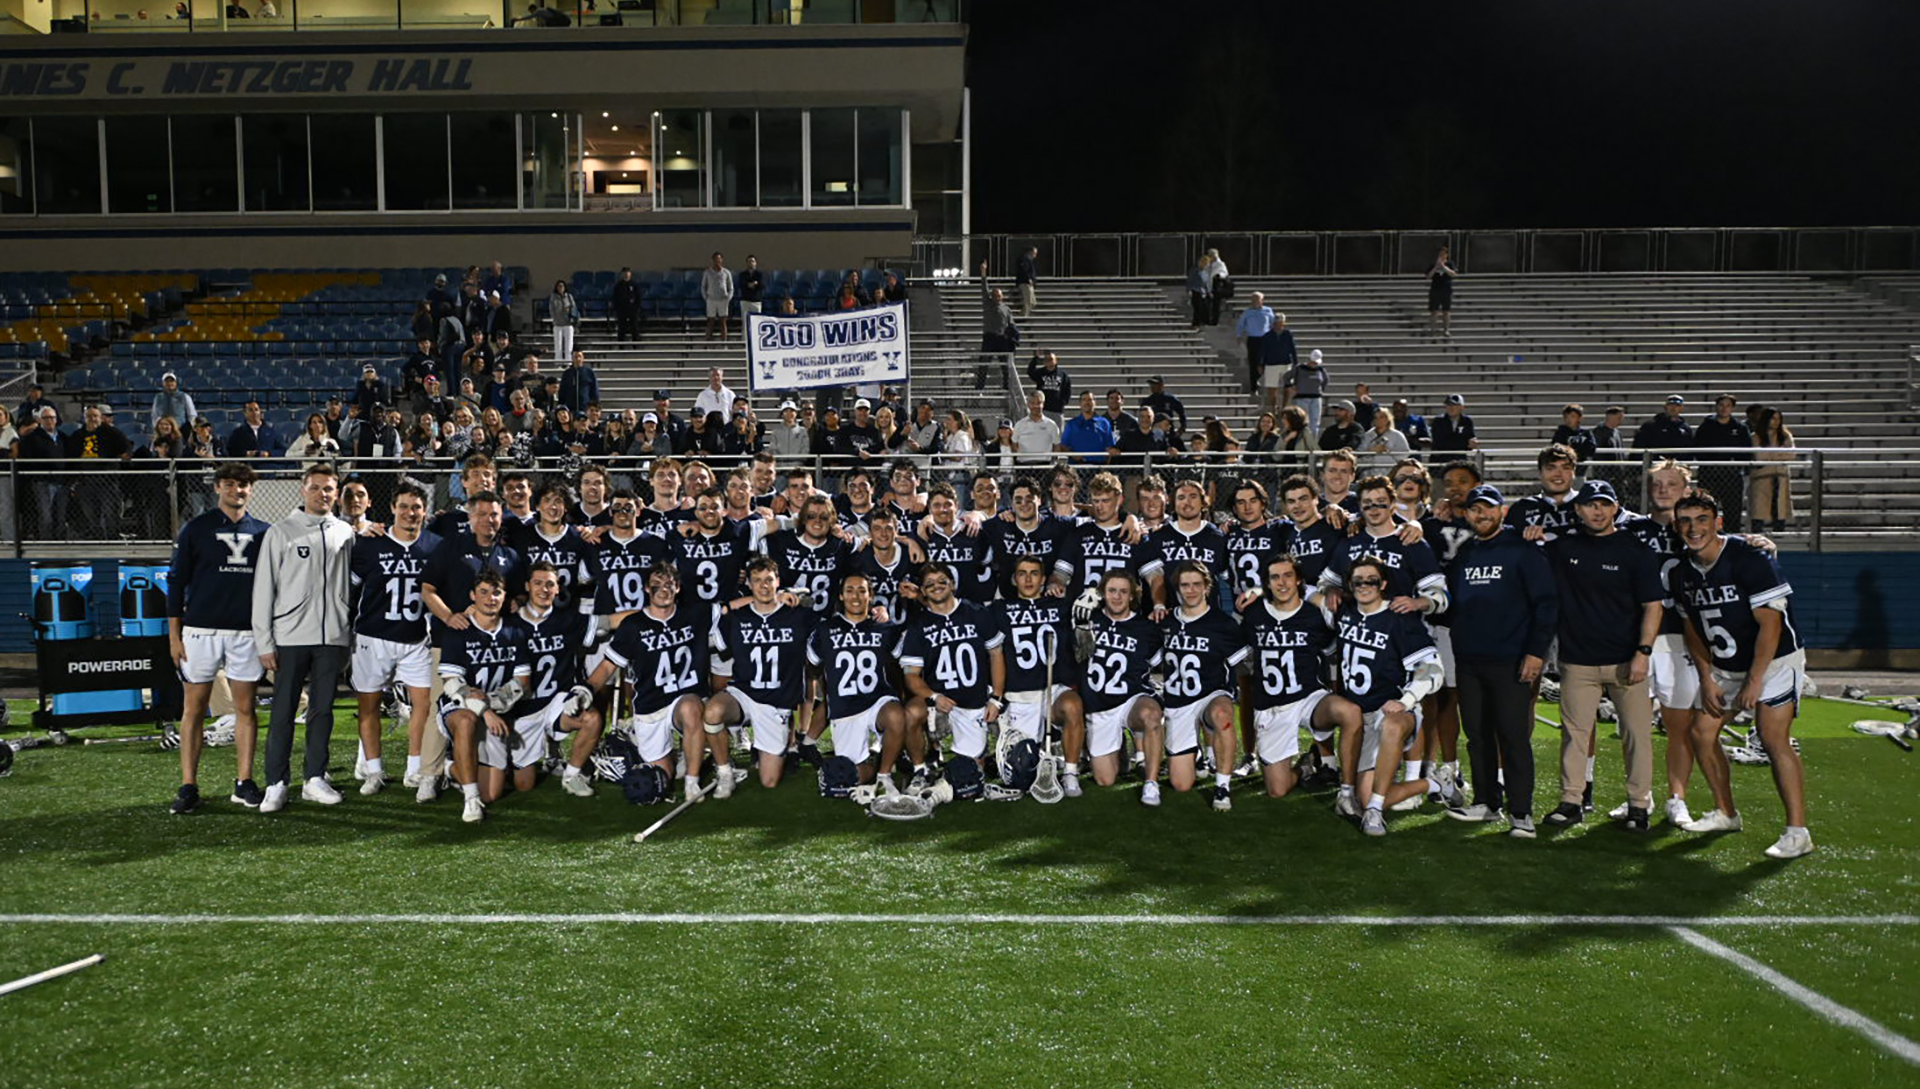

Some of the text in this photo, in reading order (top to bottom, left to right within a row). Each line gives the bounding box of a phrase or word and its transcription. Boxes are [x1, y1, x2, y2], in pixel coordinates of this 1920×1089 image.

[0, 58, 473, 95] MES C. METZGER HALL
[758, 312, 898, 351] 200 WINS
[781, 350, 878, 368] CONGRATULATIONS
[215, 532, 254, 565] Y
[682, 541, 733, 558] YALE
[927, 547, 973, 562] YALE
[1003, 539, 1053, 555] YALE
[1081, 542, 1132, 558] YALE
[1161, 546, 1215, 563] YALE
[380, 558, 428, 575] YAL
[600, 555, 651, 571] YALE
[786, 555, 836, 572] YALE
[1464, 565, 1503, 580] YALE
[608, 571, 644, 611] 19
[696, 560, 719, 600] 3
[384, 577, 423, 622] 15
[1683, 584, 1740, 606] YALE
[1006, 608, 1060, 625] YALE
[641, 625, 695, 652] YALE
[740, 627, 794, 644] YALE
[830, 632, 883, 649] YALE
[924, 623, 978, 648] YALE
[1256, 631, 1308, 647] YALE
[1337, 620, 1389, 650] YALE
[1699, 608, 1738, 659] 5
[465, 646, 517, 664] YALE
[1011, 623, 1058, 670] 50
[68, 659, 153, 674] POWERADE
[654, 645, 699, 694] 42
[750, 645, 782, 689] 11
[835, 650, 878, 696] 28
[935, 642, 978, 690] 40
[1087, 649, 1128, 694] 52
[1164, 651, 1202, 697] 26
[1261, 649, 1303, 696] 51
